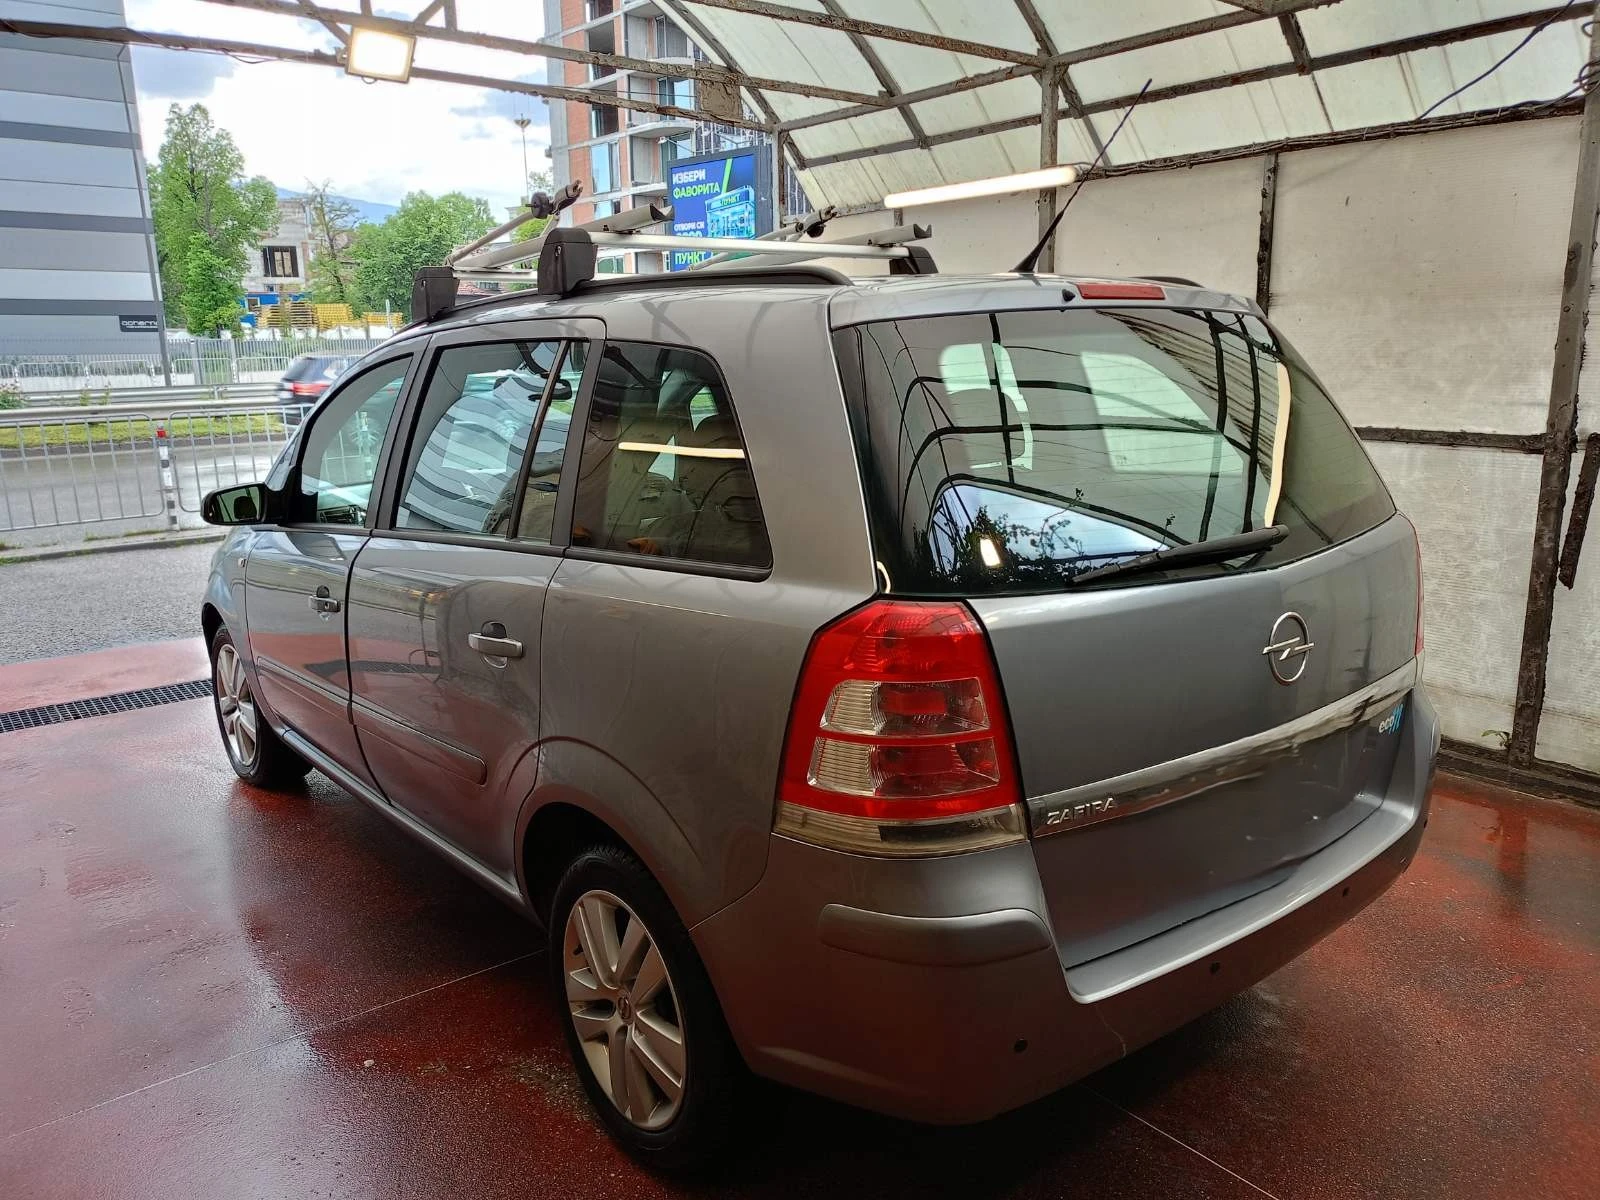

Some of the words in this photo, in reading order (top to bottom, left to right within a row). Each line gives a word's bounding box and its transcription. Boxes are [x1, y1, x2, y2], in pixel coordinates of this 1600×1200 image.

[672, 169, 706, 184] ИЗБЕРИ
[672, 182, 720, 199] ФАВОРИТА
[674, 251, 707, 266] ПУНКТ
[1046, 797, 1118, 825] ZAFIRA
